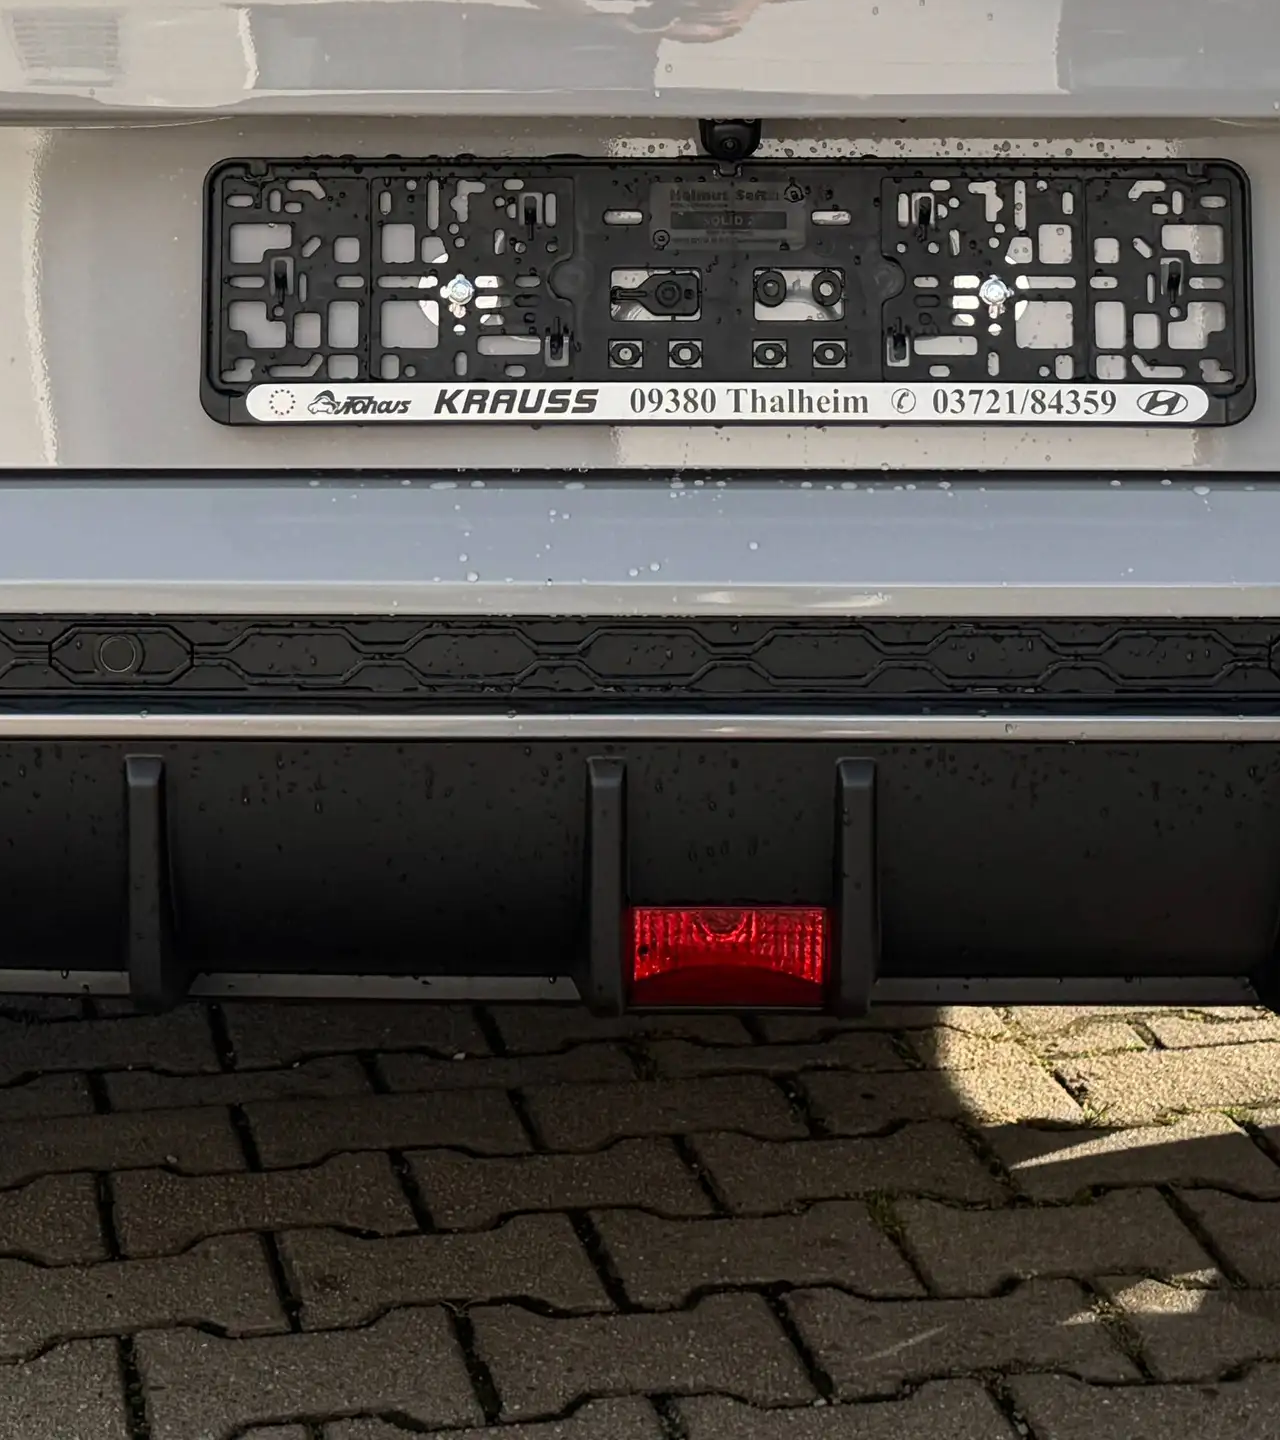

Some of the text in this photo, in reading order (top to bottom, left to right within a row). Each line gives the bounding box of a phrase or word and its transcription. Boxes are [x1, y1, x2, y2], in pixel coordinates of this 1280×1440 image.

[433, 388, 599, 414] KRAUSS
[629, 387, 717, 414] 09380
[726, 387, 869, 414] Thalheim
[932, 388, 1117, 415] 03721/84359
